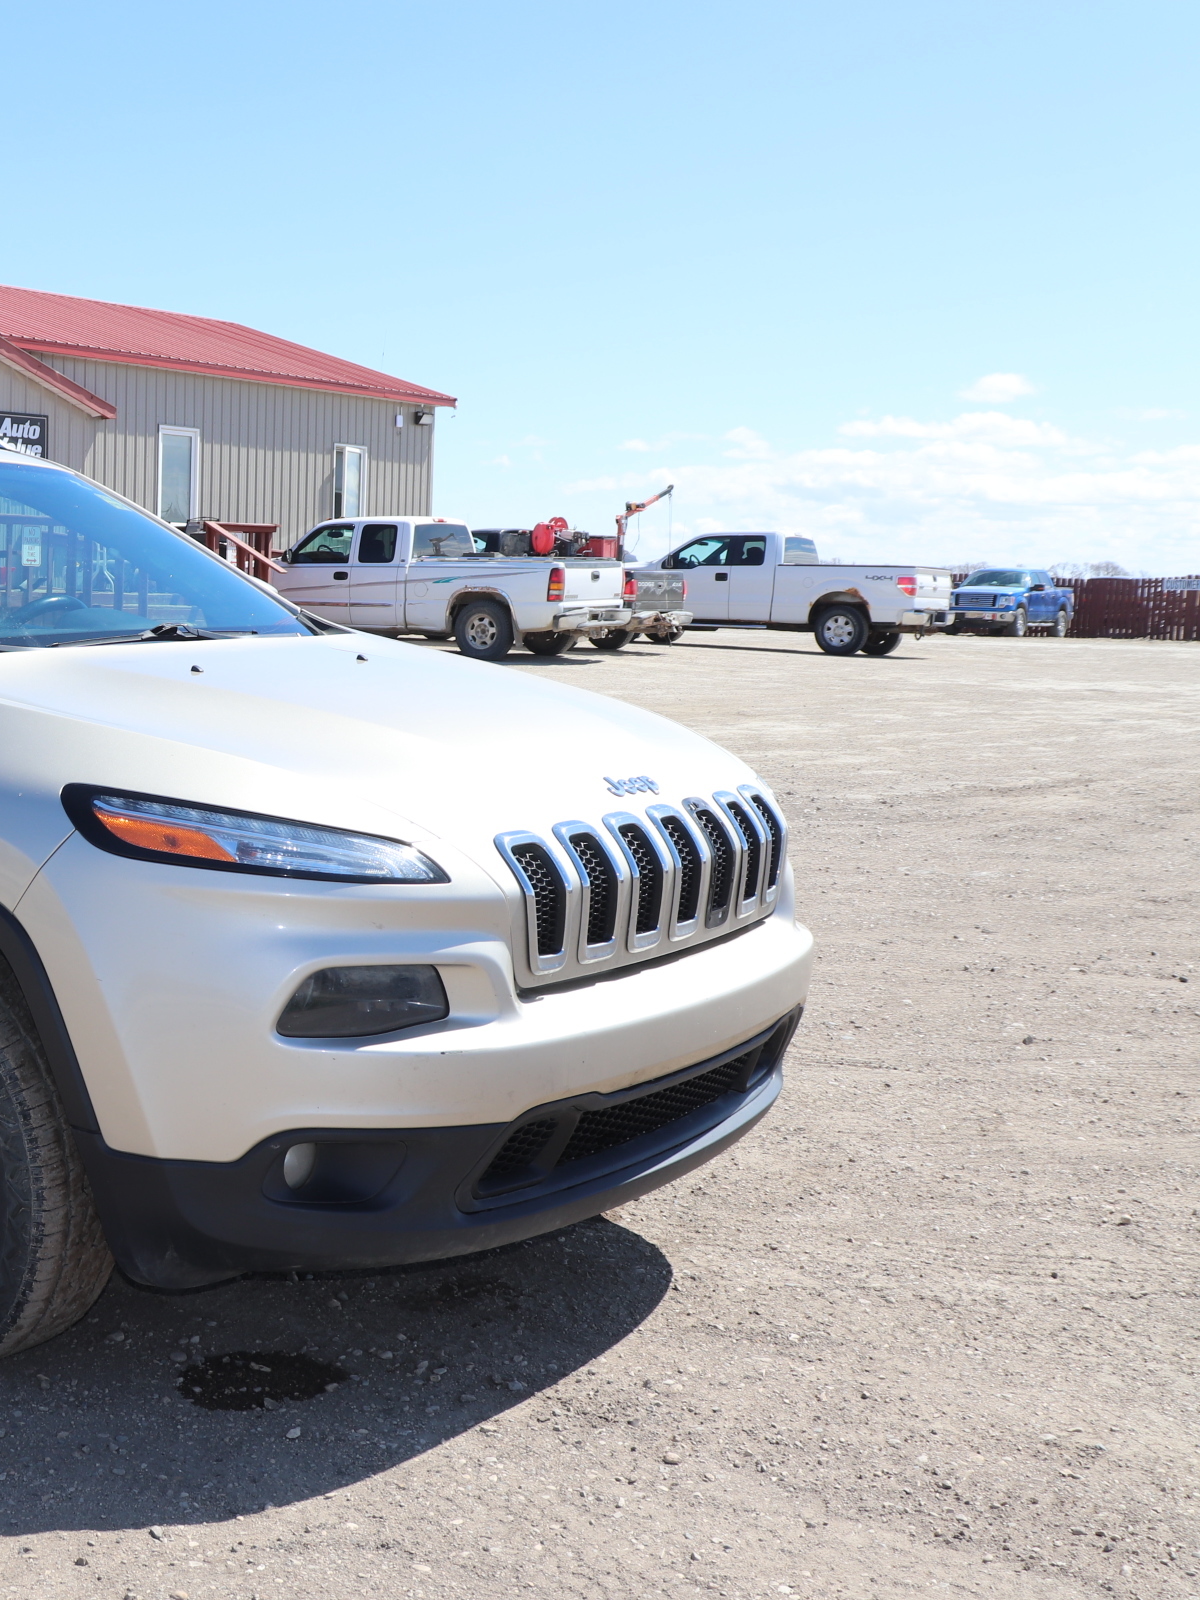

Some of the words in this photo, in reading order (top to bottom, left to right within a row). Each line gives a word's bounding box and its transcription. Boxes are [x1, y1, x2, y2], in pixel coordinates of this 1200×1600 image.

[3, 437, 42, 457] lue
[29, 528, 35, 536] NO
[603, 776, 659, 797] Jeep
